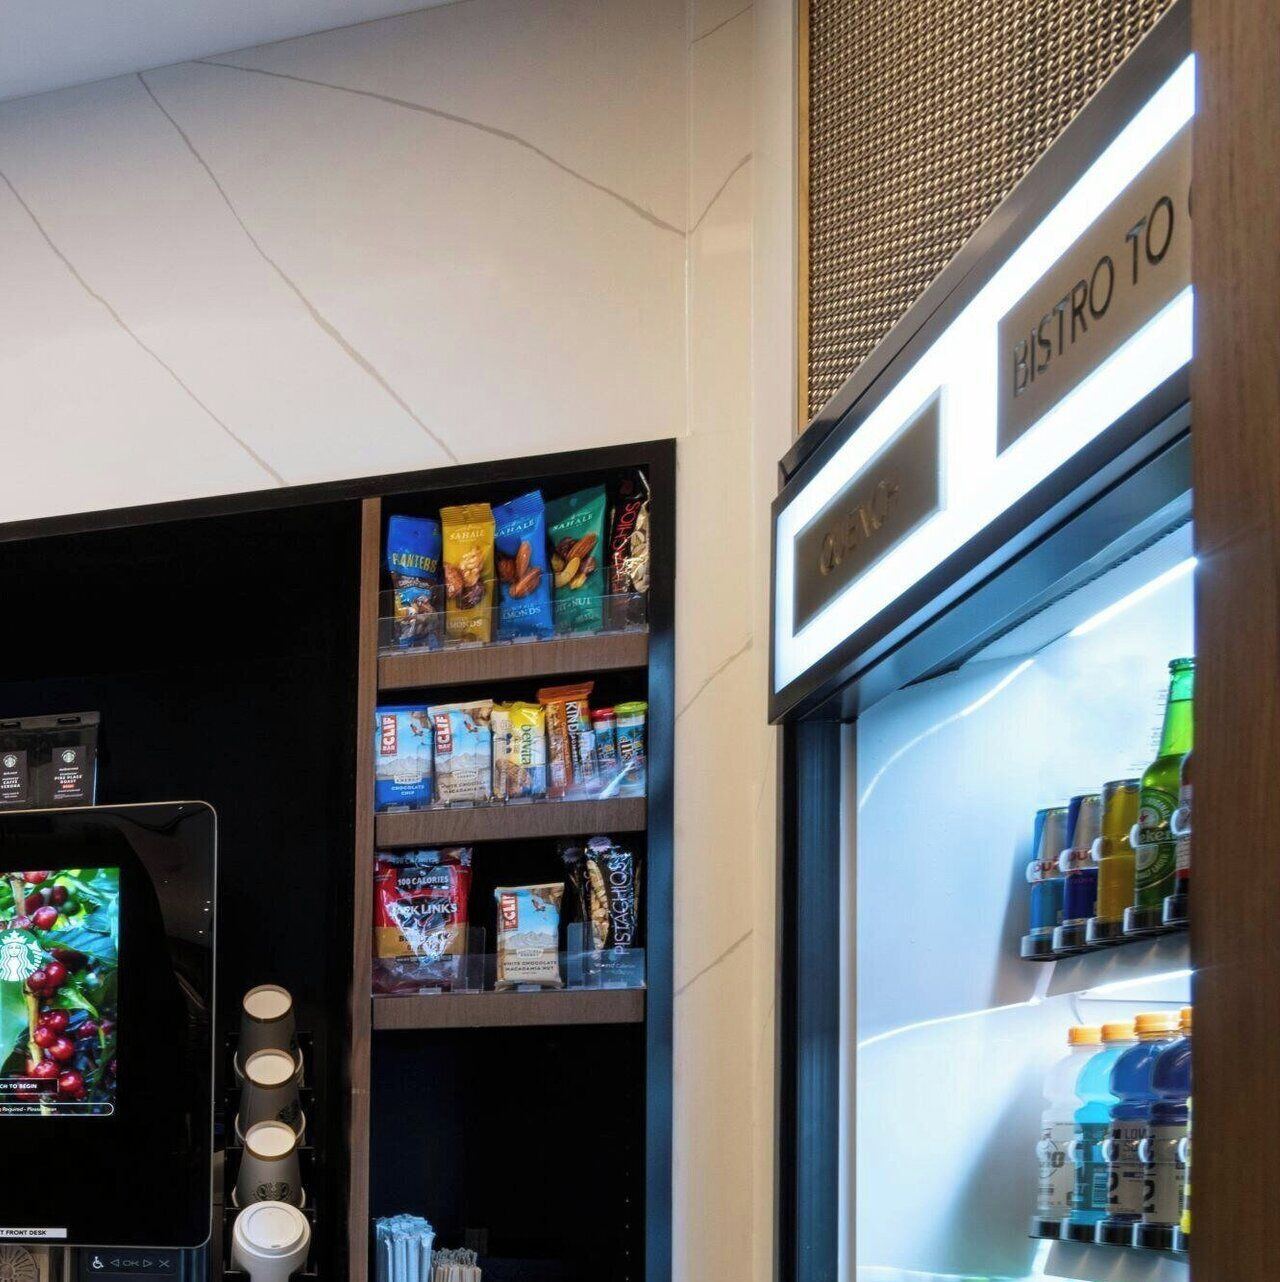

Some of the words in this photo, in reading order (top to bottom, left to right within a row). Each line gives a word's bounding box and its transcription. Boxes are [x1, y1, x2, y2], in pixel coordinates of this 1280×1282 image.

[1013, 255, 1115, 399] BISTRO
[1125, 195, 1175, 286] TO
[382, 716, 395, 745] CLIF
[436, 716, 450, 744] CLIF
[564, 701, 579, 731] KIND
[397, 877, 411, 886] 100
[411, 875, 449, 885] CALORIES
[609, 860, 630, 955] PISTACHIOS
